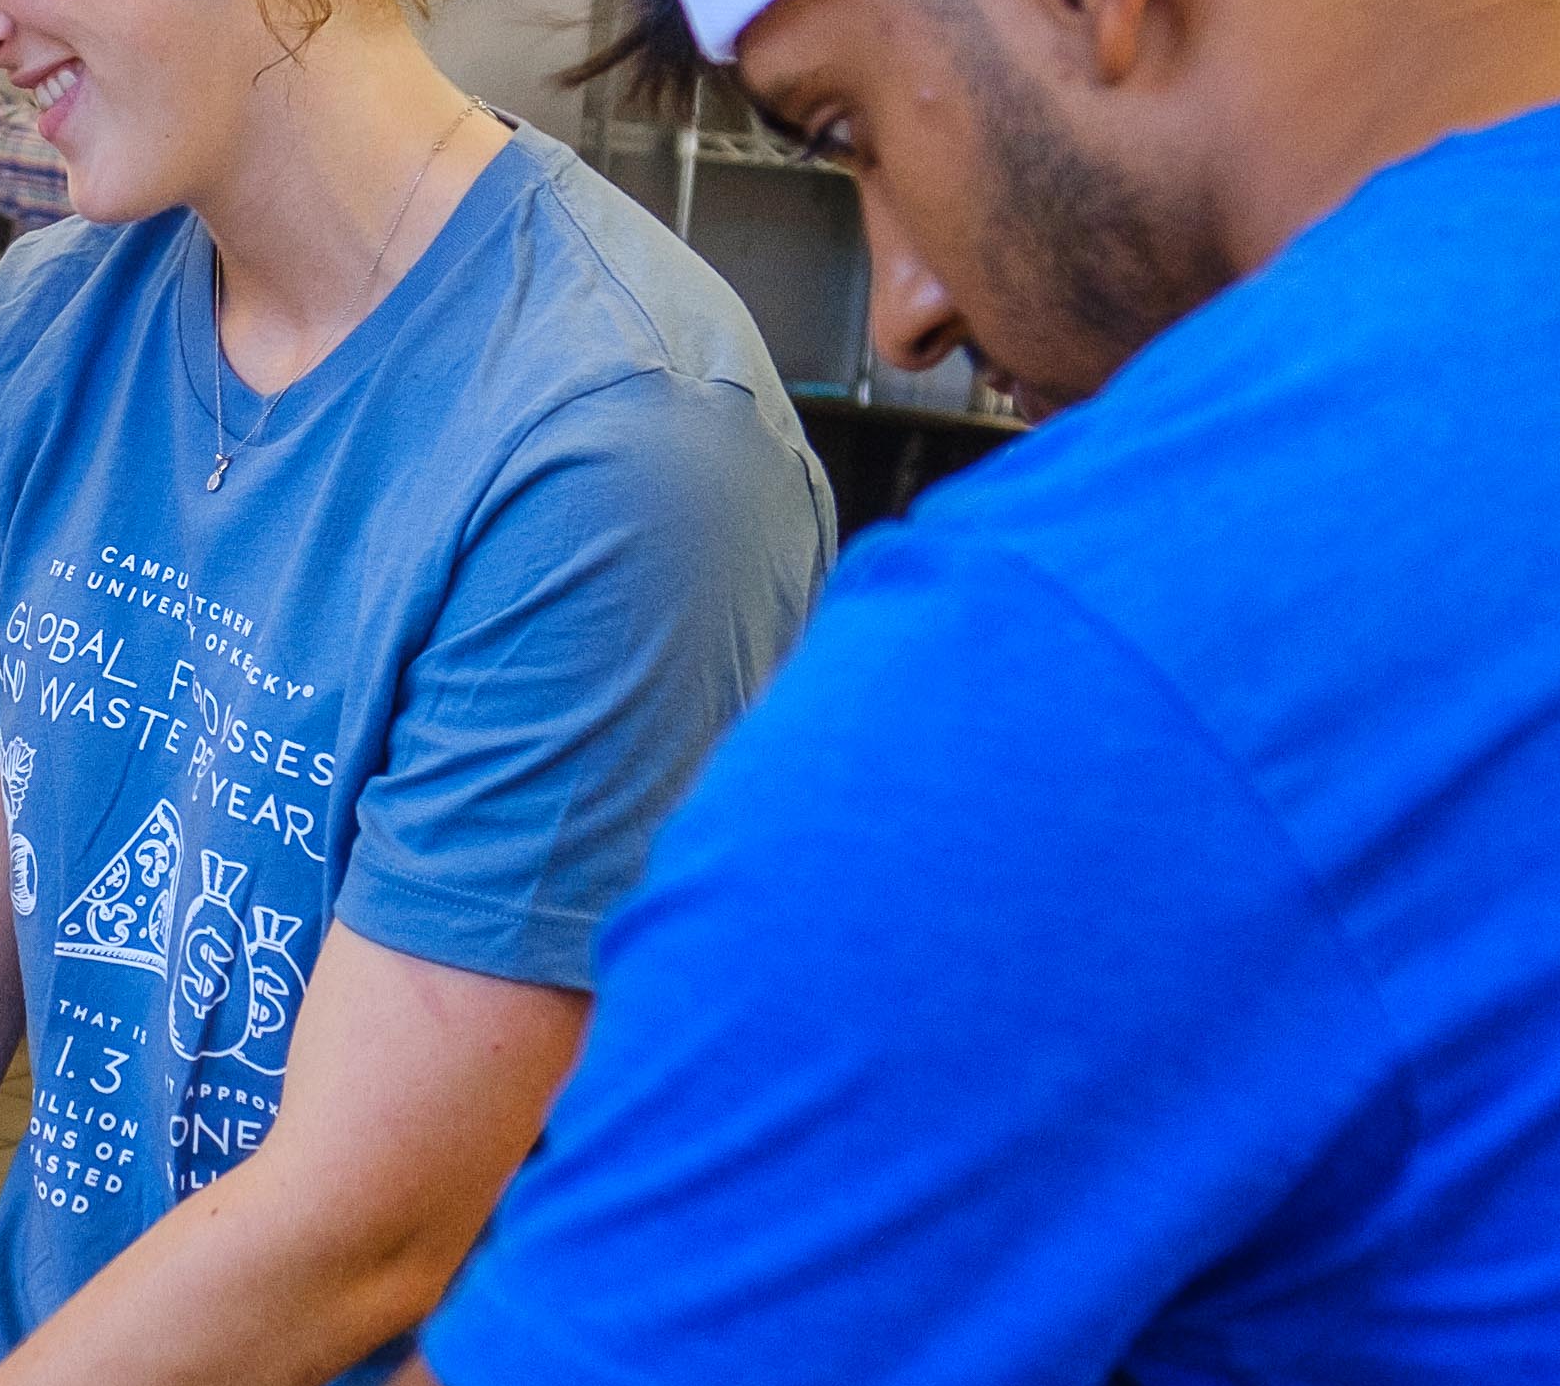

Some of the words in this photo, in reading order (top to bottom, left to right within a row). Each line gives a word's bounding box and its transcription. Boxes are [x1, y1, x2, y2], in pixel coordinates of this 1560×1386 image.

[49, 559, 77, 582] THE
[205, 633, 228, 656] OF
[101, 545, 190, 591] CAMPU
[188, 592, 254, 637] ITCHEN
[6, 601, 138, 689] GLOBAL
[40, 670, 188, 754] WASTE
[211, 771, 326, 862] YEAR
[58, 999, 122, 1032] THAT
[132, 1026, 147, 1045] IS
[55, 1035, 130, 1094] 1.3
[33, 1088, 139, 1140] ILLION
[185, 1083, 279, 1118] APPROX
[30, 1116, 78, 1150] ONS
[95, 1143, 135, 1166] OF
[169, 1113, 263, 1156] ONE
[34, 1174, 89, 1214] OOD
